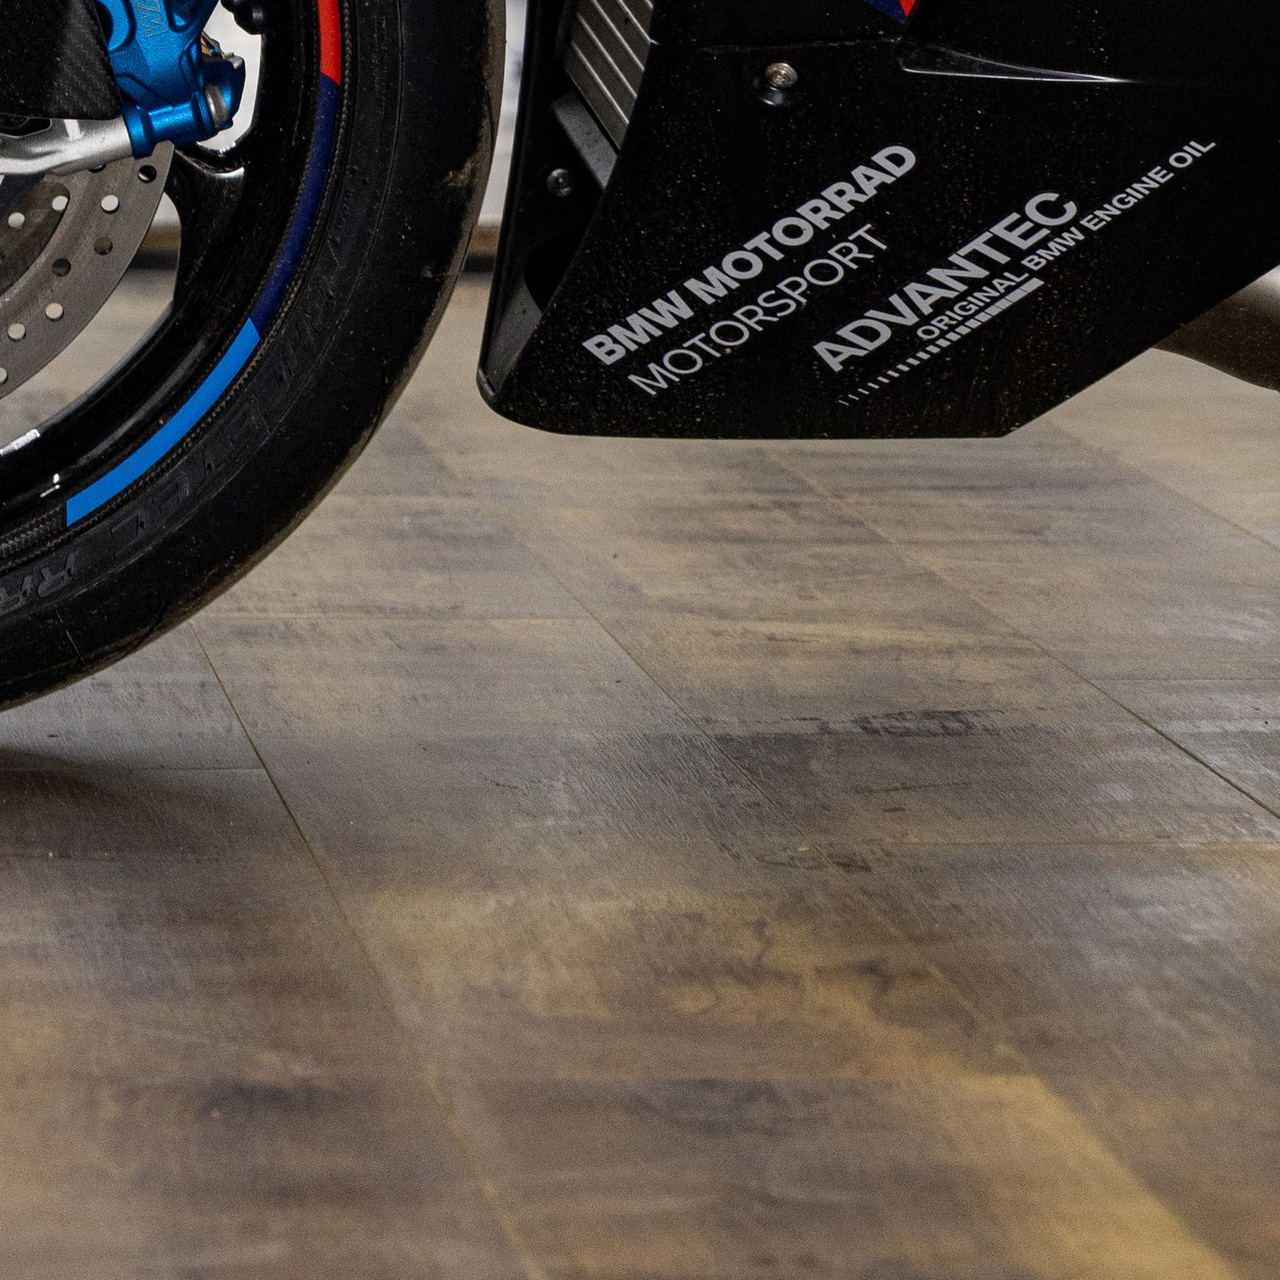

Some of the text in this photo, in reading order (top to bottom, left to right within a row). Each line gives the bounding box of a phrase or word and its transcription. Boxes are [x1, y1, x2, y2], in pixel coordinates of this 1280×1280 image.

[582, 145, 917, 365] BMW MOTORRAD
[628, 223, 888, 395] MOTORSPORT
[813, 191, 1078, 372] ADVANTEC
[916, 139, 1216, 341] ORIGINAL BMW ENGINE OIL
